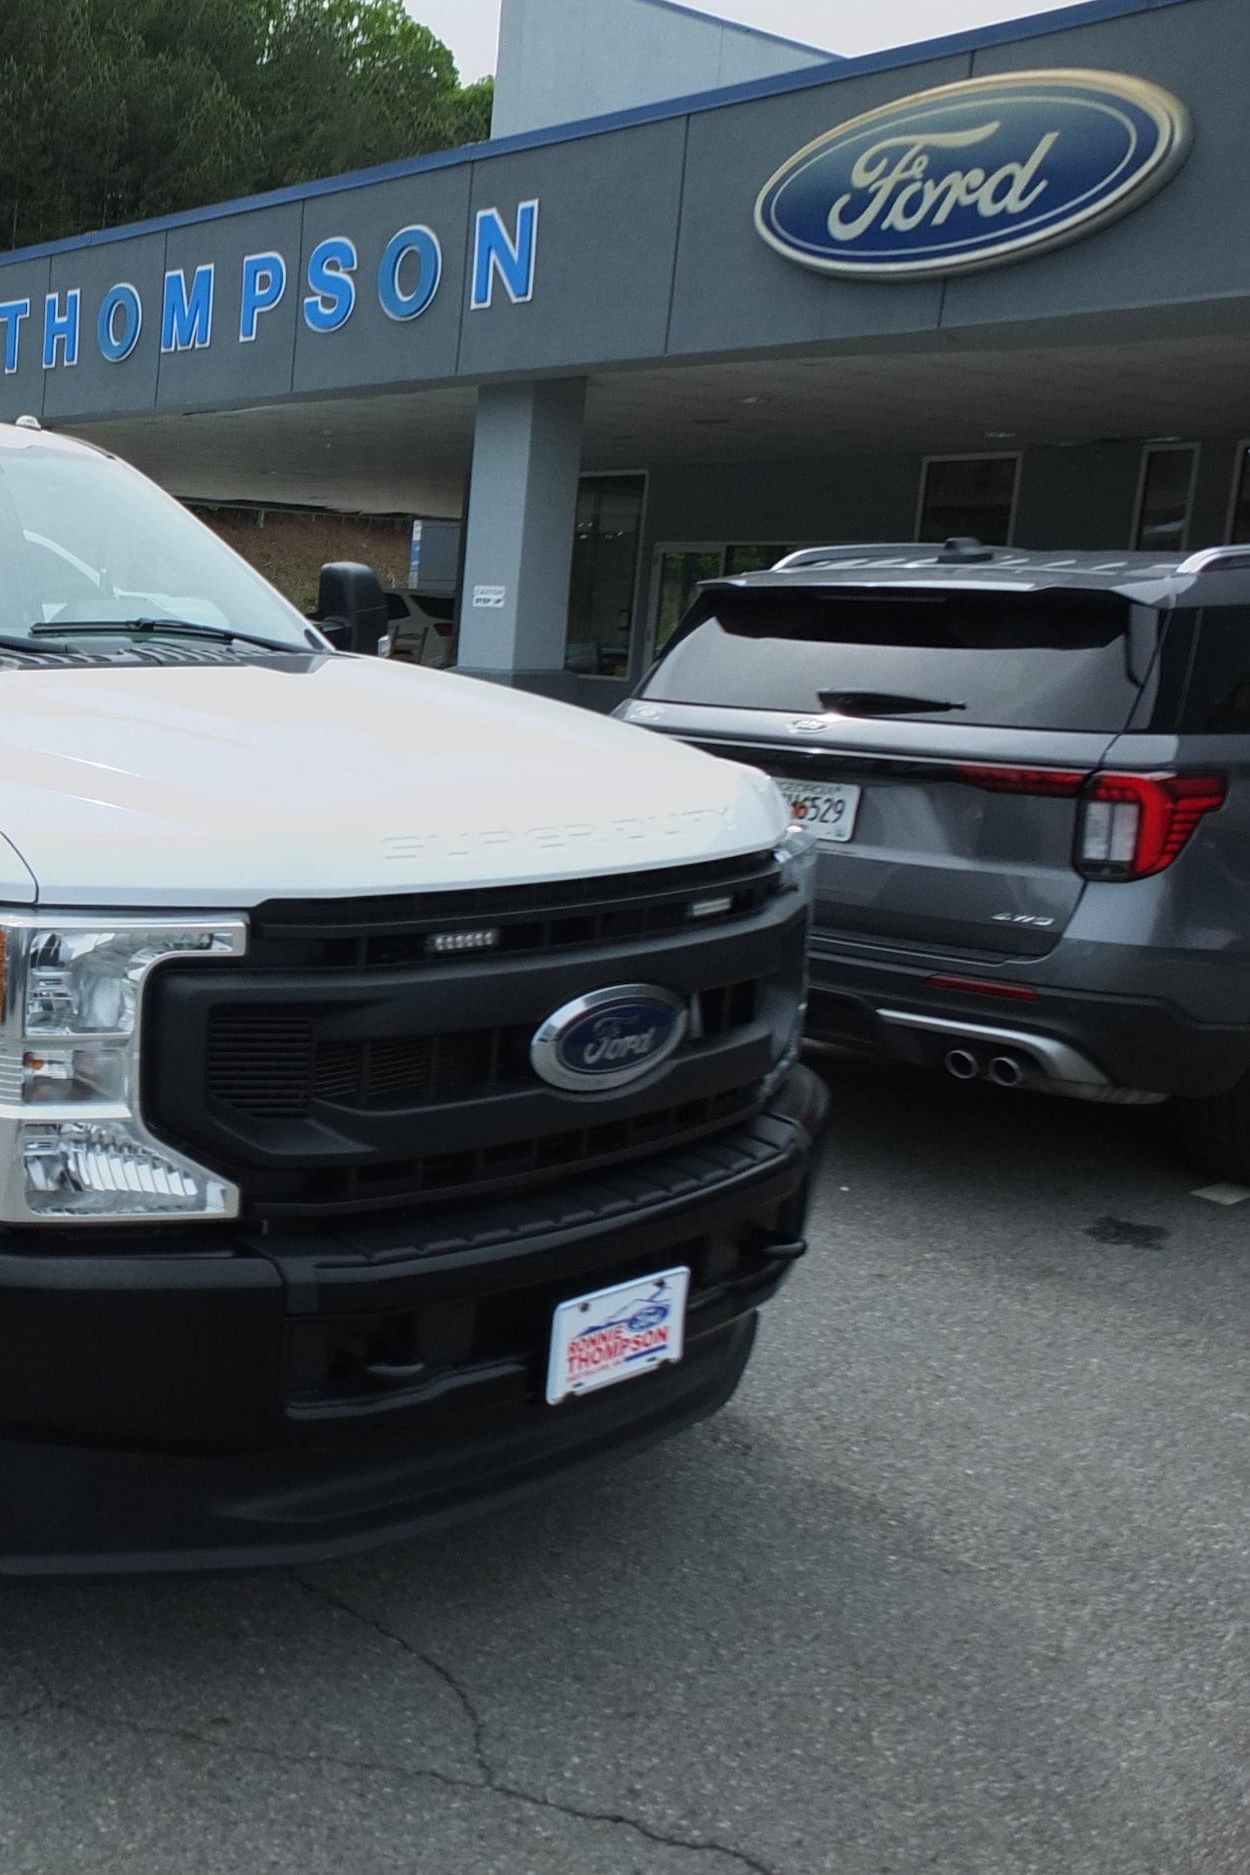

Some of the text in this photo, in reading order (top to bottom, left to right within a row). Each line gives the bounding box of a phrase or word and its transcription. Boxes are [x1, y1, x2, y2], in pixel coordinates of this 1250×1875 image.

[827, 120, 1060, 242] Ford
[583, 1014, 655, 1064] Ford
[568, 1325, 624, 1352] RONNIE
[568, 1326, 669, 1373] THOMPSON
